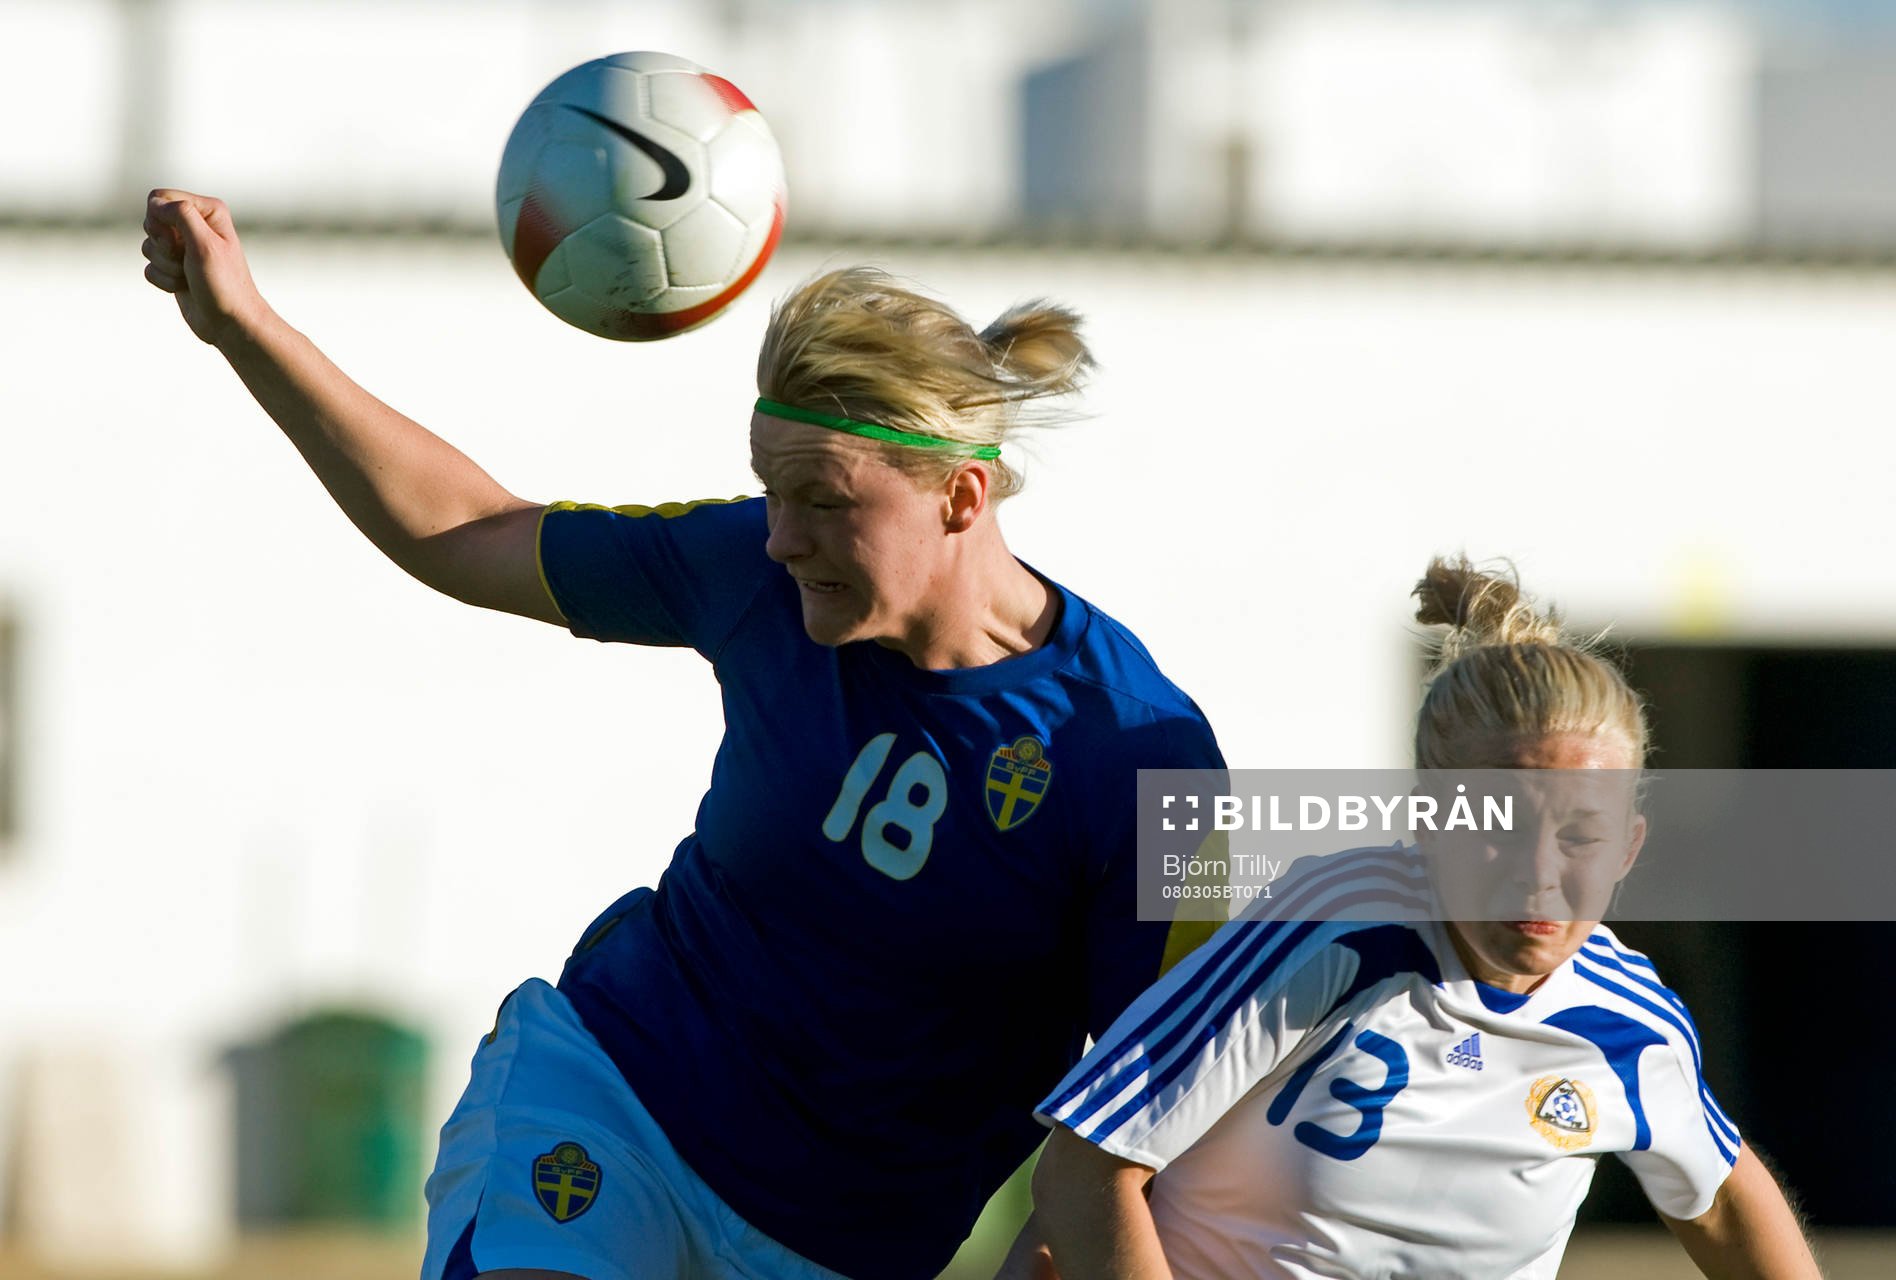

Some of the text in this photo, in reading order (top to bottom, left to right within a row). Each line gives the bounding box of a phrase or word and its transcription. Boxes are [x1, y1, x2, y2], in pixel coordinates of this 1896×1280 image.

[822, 732, 948, 880] 18
[1266, 1021, 1410, 1161] 13
[1446, 1053, 1483, 1071] adidas
